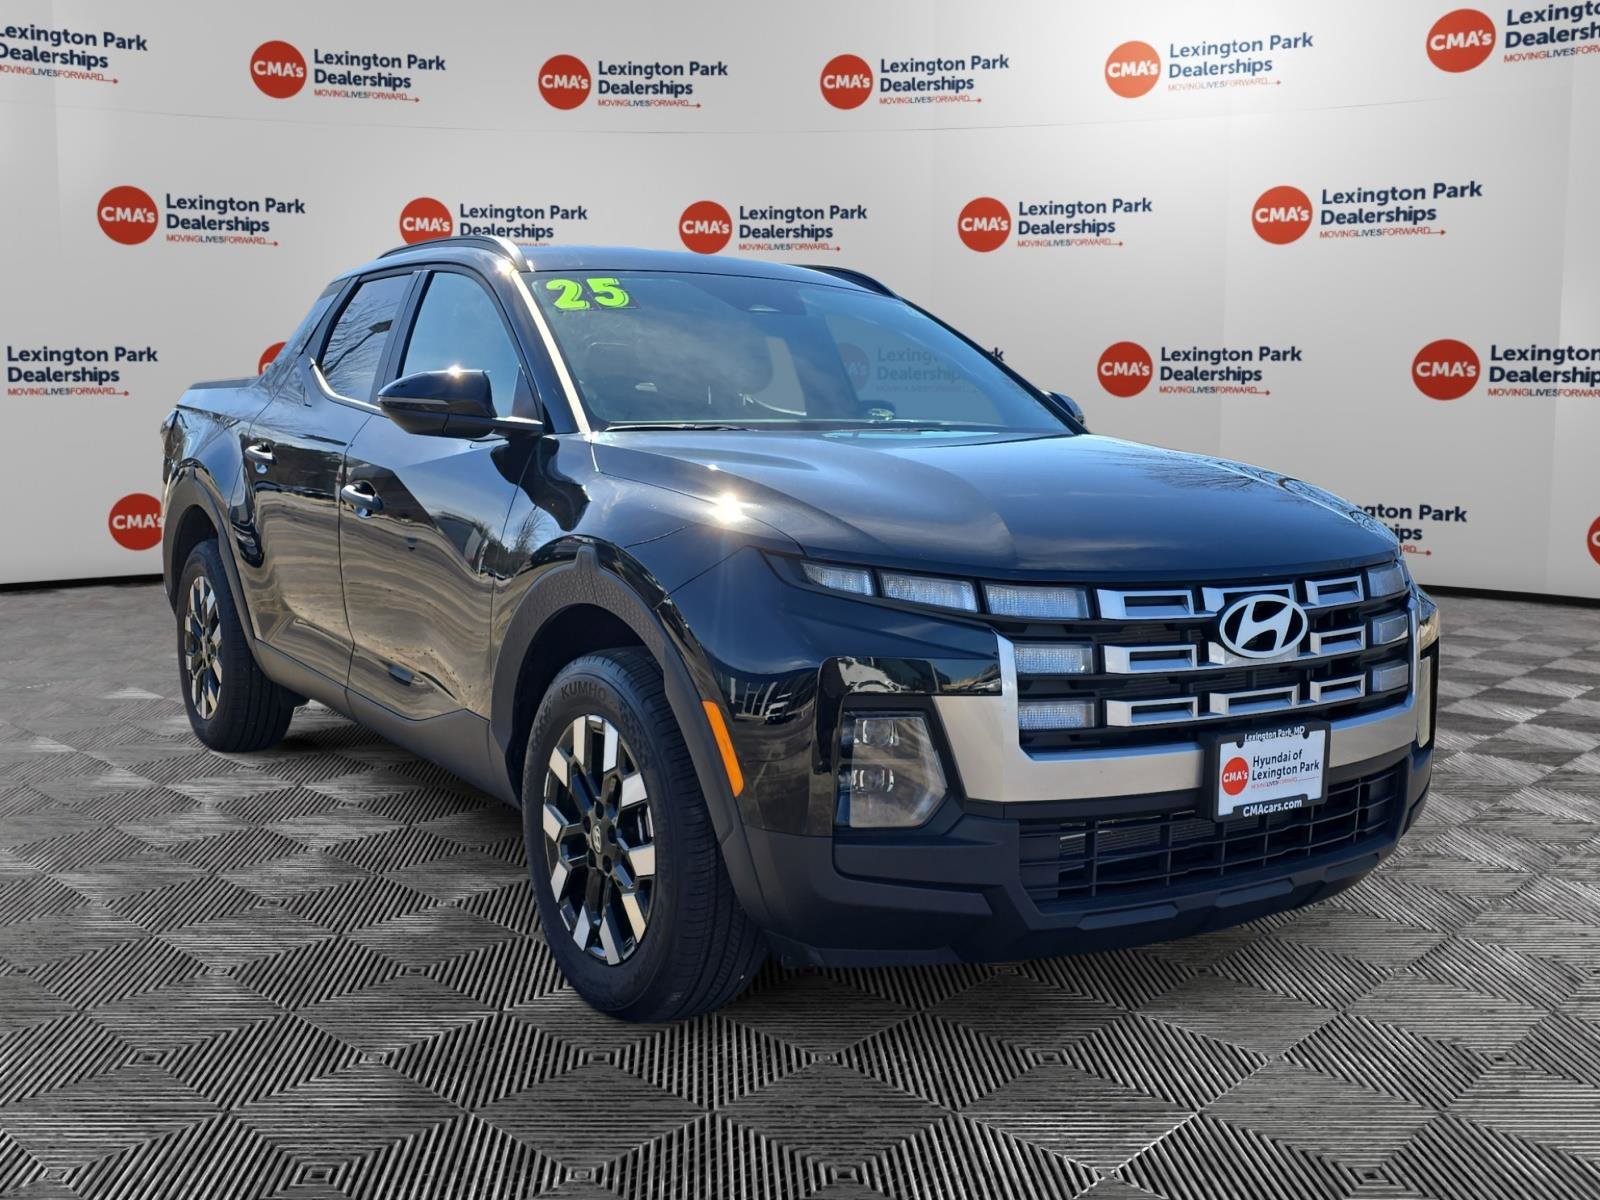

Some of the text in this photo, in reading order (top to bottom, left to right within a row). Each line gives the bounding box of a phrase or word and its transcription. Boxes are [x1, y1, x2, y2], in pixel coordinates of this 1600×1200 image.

[104, 32, 148, 51] Park
[1170, 32, 1313, 58] Lexington Park
[1430, 30, 1492, 51] CMA's
[314, 49, 446, 70] Lexington Park
[881, 54, 1009, 75] Lexington Park
[1107, 60, 1158, 77] CMA's
[1169, 58, 1272, 78] Dealerships
[254, 61, 304, 77] CMA's
[598, 61, 728, 79] Lexington Park
[314, 70, 411, 91] Dealerships
[542, 74, 588, 89] CMA's
[598, 80, 692, 98] Dealerships
[823, 74, 870, 89] CMA's
[880, 76, 974, 93] Dealerships
[314, 90, 408, 100] MOVINGLIVESFORWARD
[880, 96, 970, 104] MOVINGLIVESFORWARD
[1322, 181, 1482, 206] Lexington Park
[166, 193, 305, 214] Lexington Park
[460, 203, 587, 221] Lexington Park
[1019, 198, 1152, 218] Lexington Park
[101, 207, 155, 223] CMA's
[740, 205, 867, 223] Lexington Park
[1255, 206, 1310, 223] CMA's
[1321, 206, 1436, 225] Dealerships
[166, 214, 269, 235] Dealerships
[403, 217, 450, 232] CMA's
[460, 223, 554, 240] Dealerships
[682, 220, 729, 234] CMA's
[739, 224, 833, 241] Dealerships
[961, 216, 1008, 231] CMA's
[1019, 219, 1115, 236] Dealerships
[1320, 227, 1430, 238] MOVINGLIVESFORWARD
[166, 234, 266, 244] MOVINGLIVESFORWARD
[1018, 238, 1111, 247] MOVINGLIVESFORWARD
[546, 278, 630, 310] 25
[7, 346, 158, 365] Lexington Park
[878, 347, 936, 365] Lexing
[1161, 347, 1301, 365] Lexington Park
[1491, 344, 1600, 365] Lexington
[8, 367, 119, 385] Dealerships
[878, 366, 961, 383] Dealership
[1101, 362, 1150, 377] CMA's
[1160, 366, 1262, 384] Dealerships
[1416, 361, 1476, 377] CMA's
[8, 387, 116, 396] MOVINGLIVESFORWARD
[1160, 386, 1258, 394] MOVINGLIVESFORWARD
[1420, 504, 1467, 522] Park
[1244, 730, 1276, 741] Lexington
[1294, 726, 1305, 734] MD
[1253, 749, 1302, 768] Hyundai of
[1223, 770, 1248, 783] CMA's
[1252, 760, 1319, 781] Lexington Park
[1243, 799, 1302, 817] CMAcars.com
